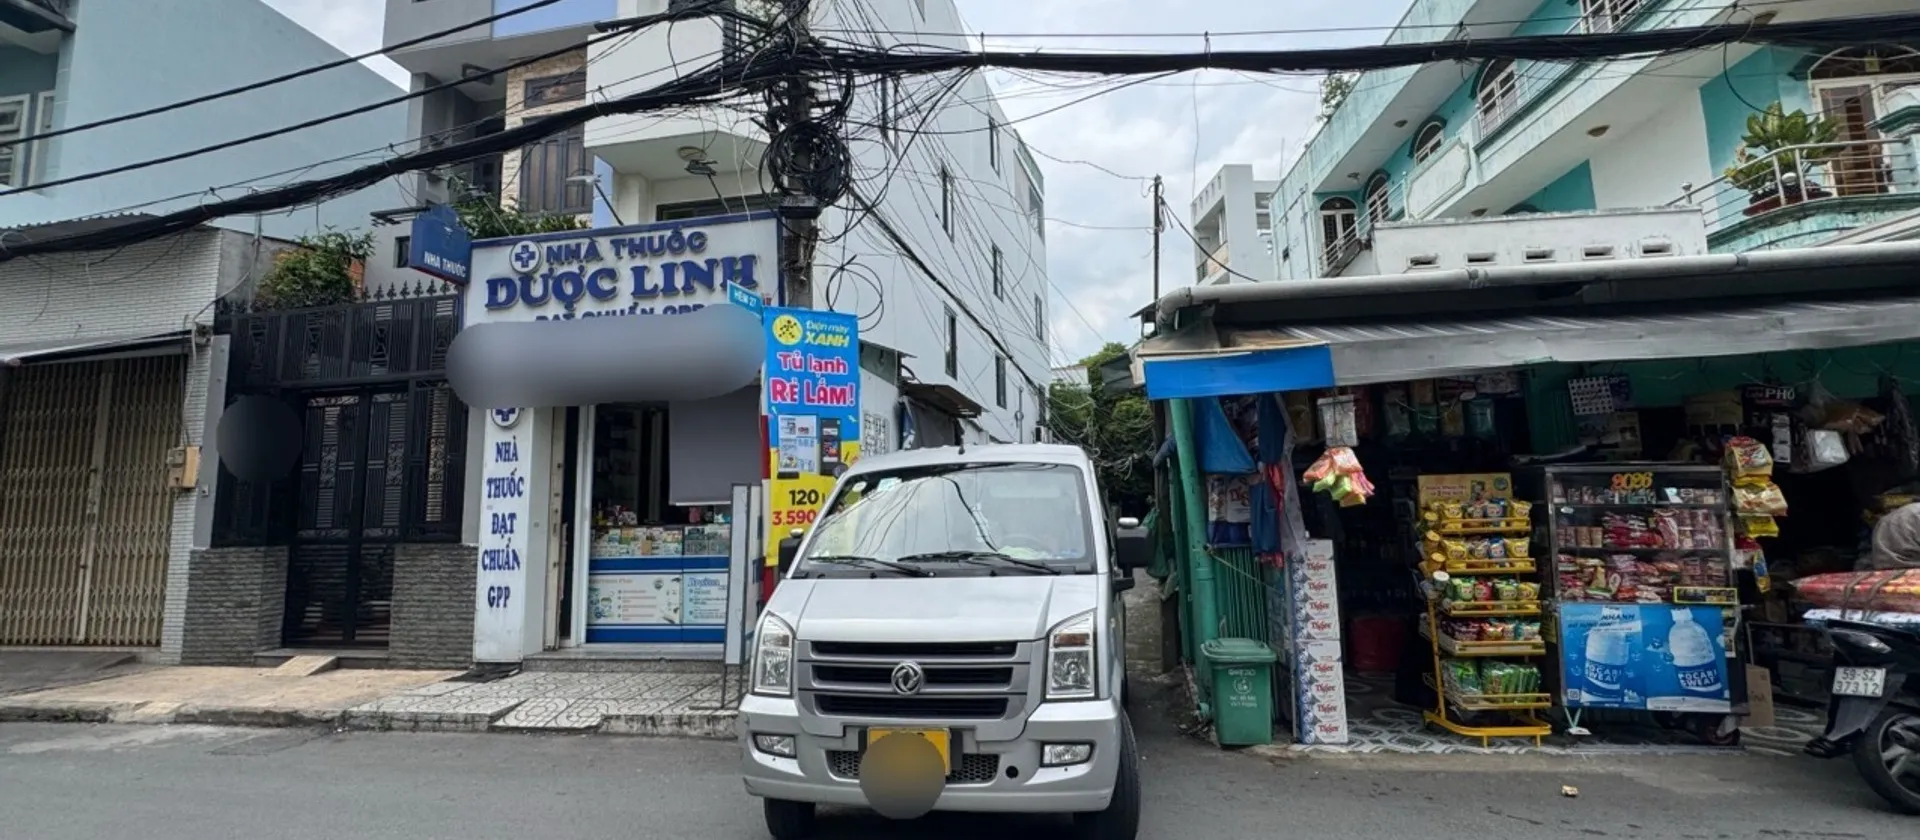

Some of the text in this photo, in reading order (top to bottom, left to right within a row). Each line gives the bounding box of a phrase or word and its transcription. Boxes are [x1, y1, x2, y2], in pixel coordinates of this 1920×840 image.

[545, 224, 708, 263] NHÀ THUỐC
[485, 265, 618, 311] DƯỢC
[630, 255, 758, 297] LINH
[804, 332, 850, 347] XANH
[777, 350, 848, 378] Tủ lạnh
[770, 377, 800, 403] RẺ
[495, 436, 519, 462] NHÀ
[487, 468, 525, 498] THUỐC
[789, 489, 819, 505] 120
[491, 512, 517, 539] ĐẠT
[482, 537, 521, 571] CHUẨN
[487, 586, 511, 608] GPP
[1677, 669, 1717, 680] POCARI
[1679, 676, 1714, 687] SWEAT
